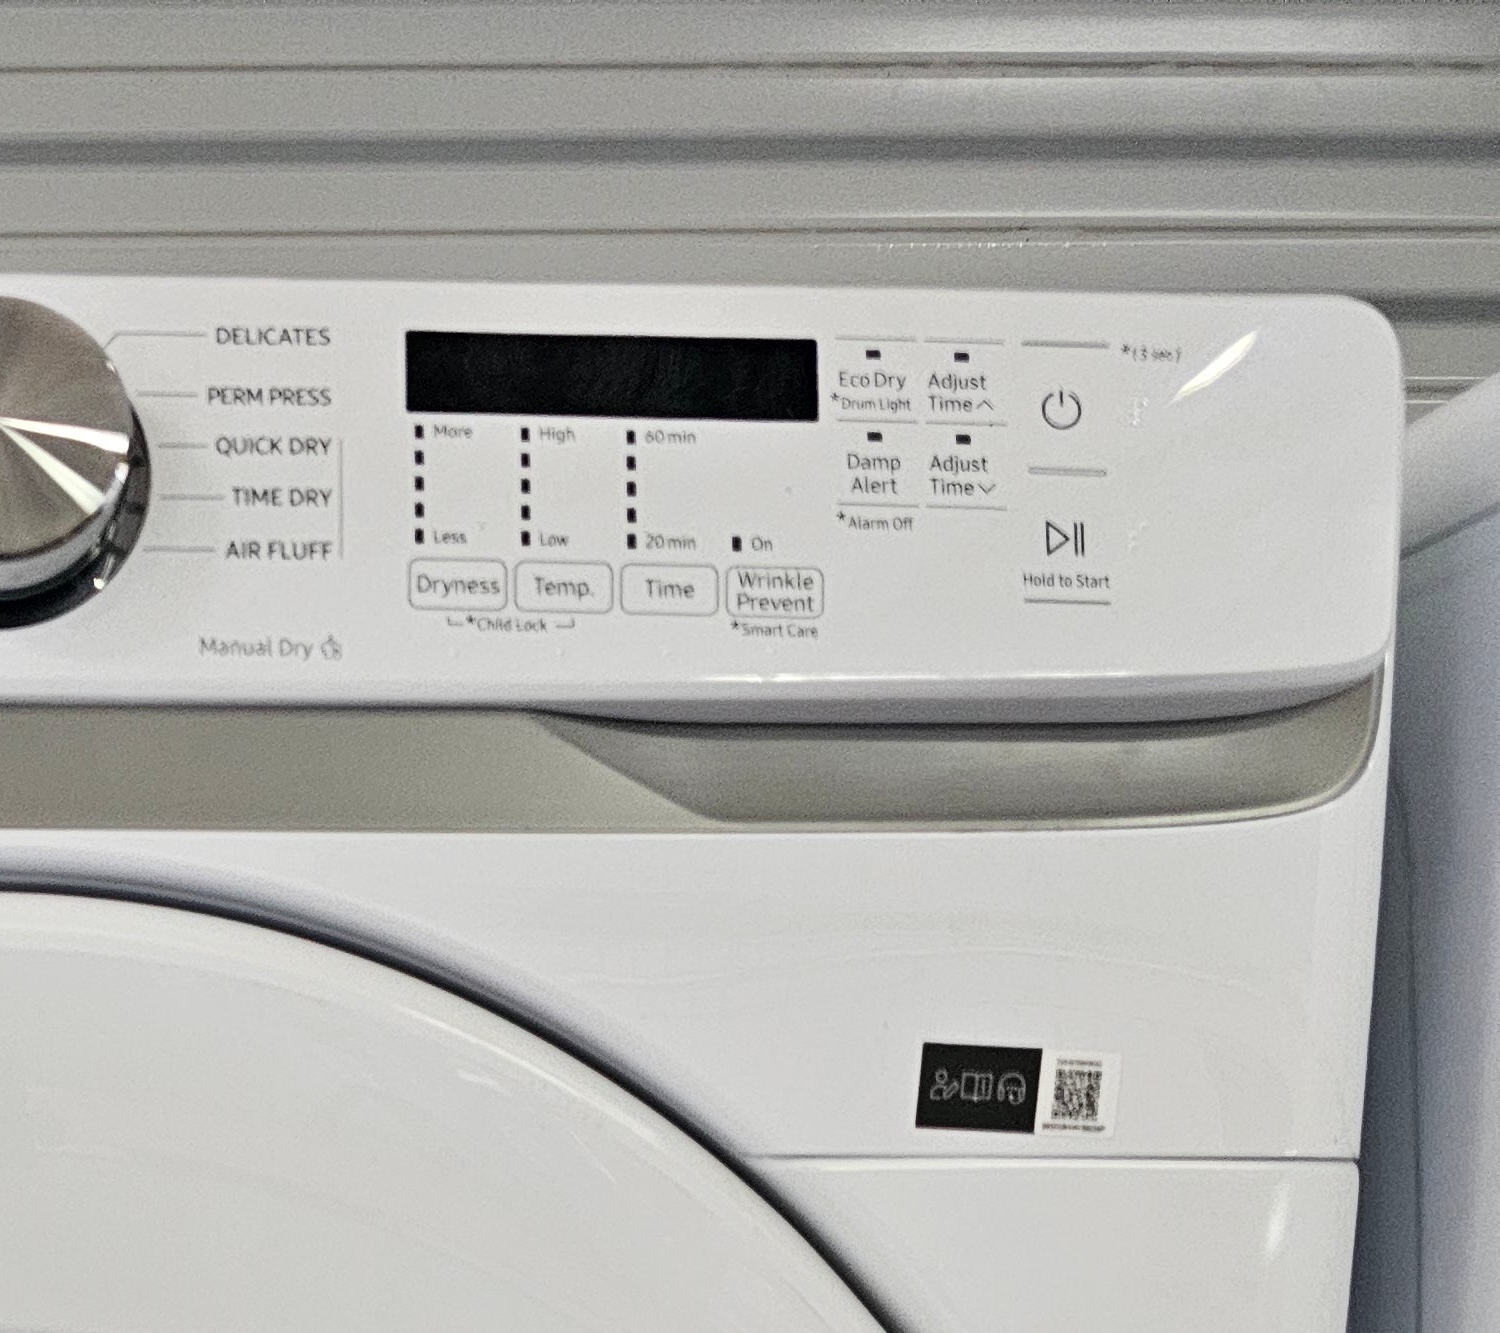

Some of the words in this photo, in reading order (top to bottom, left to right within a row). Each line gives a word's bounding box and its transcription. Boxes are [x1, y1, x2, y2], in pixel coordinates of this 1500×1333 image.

[216, 327, 331, 346] DELICATES
[839, 372, 870, 388] Eco
[874, 373, 906, 390] Dry
[929, 374, 987, 391] Adjust
[207, 387, 263, 406] PERM
[270, 388, 332, 407] PRESS
[879, 397, 911, 412] Light
[929, 396, 973, 412] Time
[433, 424, 473, 440] More
[540, 427, 575, 444] High
[216, 437, 282, 457] QUICK
[289, 437, 332, 456] DRY
[847, 454, 901, 472] Damp
[930, 455, 988, 474] Adjust
[851, 477, 897, 495] Alert
[930, 479, 974, 496] Time
[232, 487, 282, 507] TIME
[289, 488, 332, 507] DRY
[893, 516, 913, 532] Off
[434, 530, 467, 545] Less
[540, 532, 569, 547] Low
[752, 536, 773, 551] On
[225, 540, 260, 560] AIR
[268, 541, 332, 561] FLUFF
[417, 574, 500, 599] Dryness
[645, 578, 695, 598] Time
[738, 571, 814, 590] Wrinkle
[1023, 573, 1055, 588] Hold
[1059, 575, 1073, 588] to
[1076, 573, 1109, 589] Start
[737, 593, 814, 612] Prevent
[516, 617, 547, 633] Lock
[788, 623, 818, 639] Care
[200, 637, 272, 658] Manual
[279, 638, 313, 662] Dry
